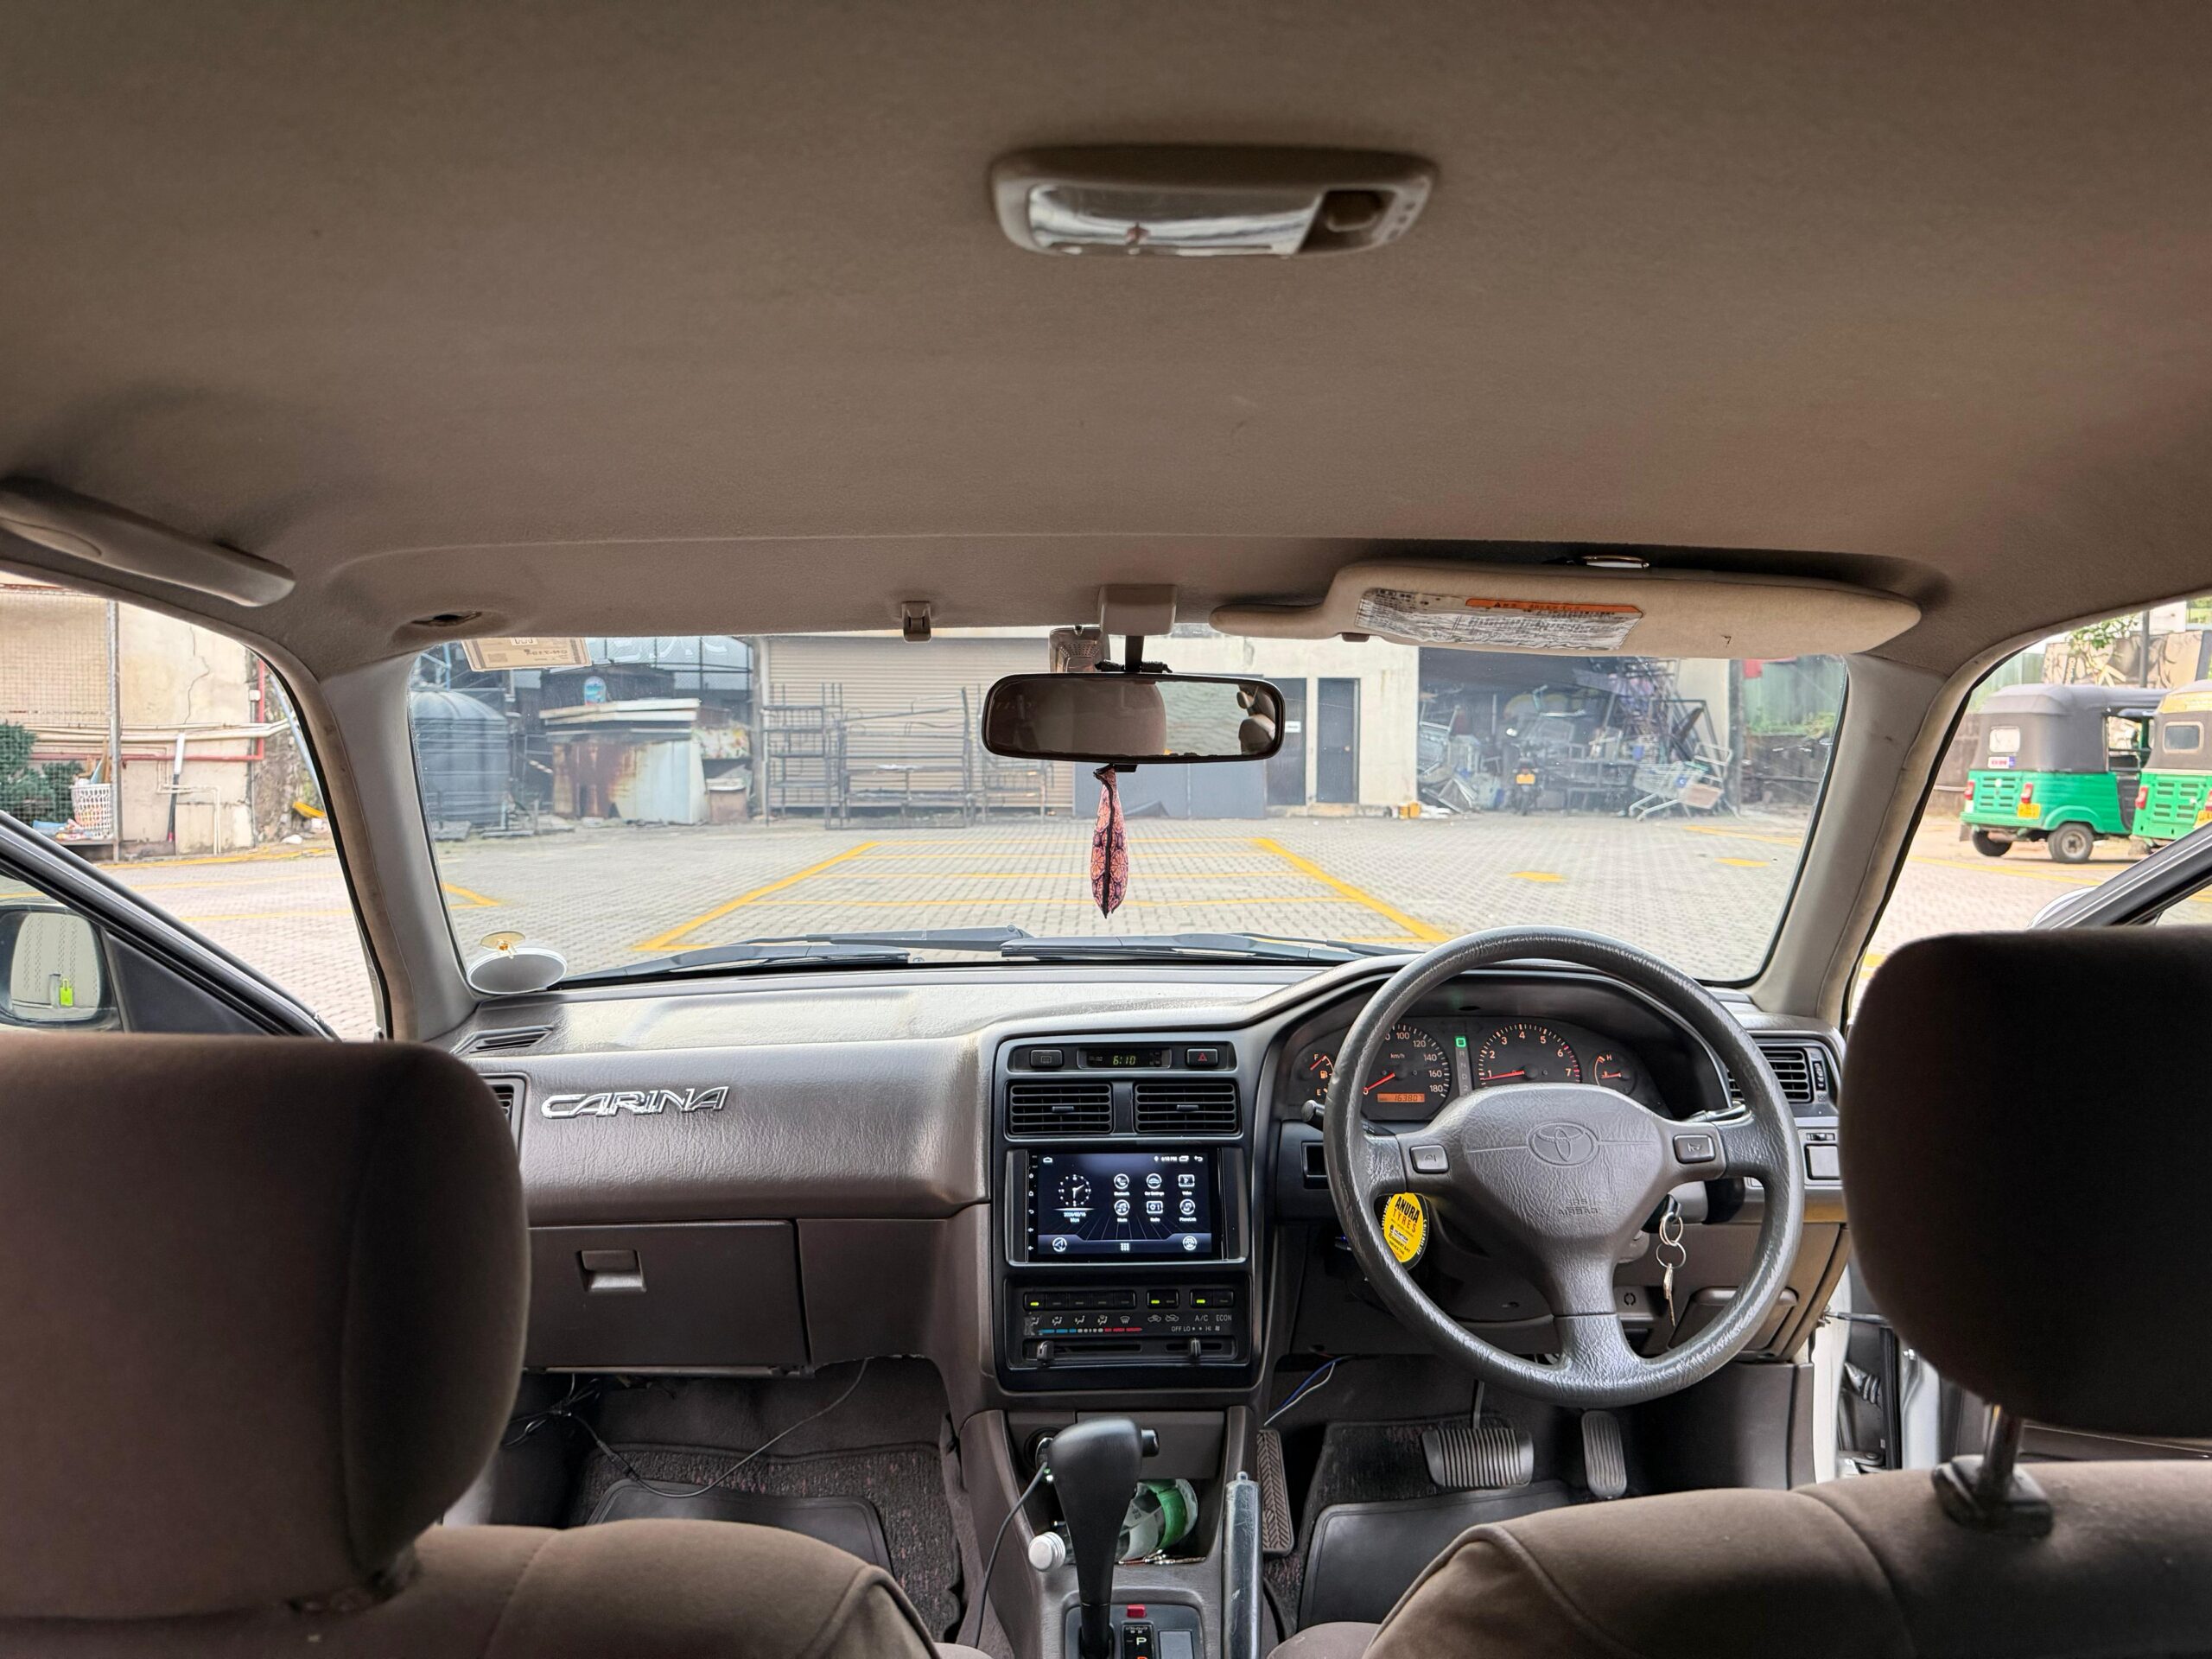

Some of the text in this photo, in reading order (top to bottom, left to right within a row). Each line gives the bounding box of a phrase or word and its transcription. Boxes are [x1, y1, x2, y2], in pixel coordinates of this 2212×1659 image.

[1113, 1055, 1136, 1065] 6:10
[1490, 1051, 1495, 1059] 2
[1566, 1068, 1572, 1077] 7
[541, 1085, 729, 1120] CARINA
[1395, 1196, 1421, 1224] ANURA
[1393, 1208, 1417, 1233] TYRES
